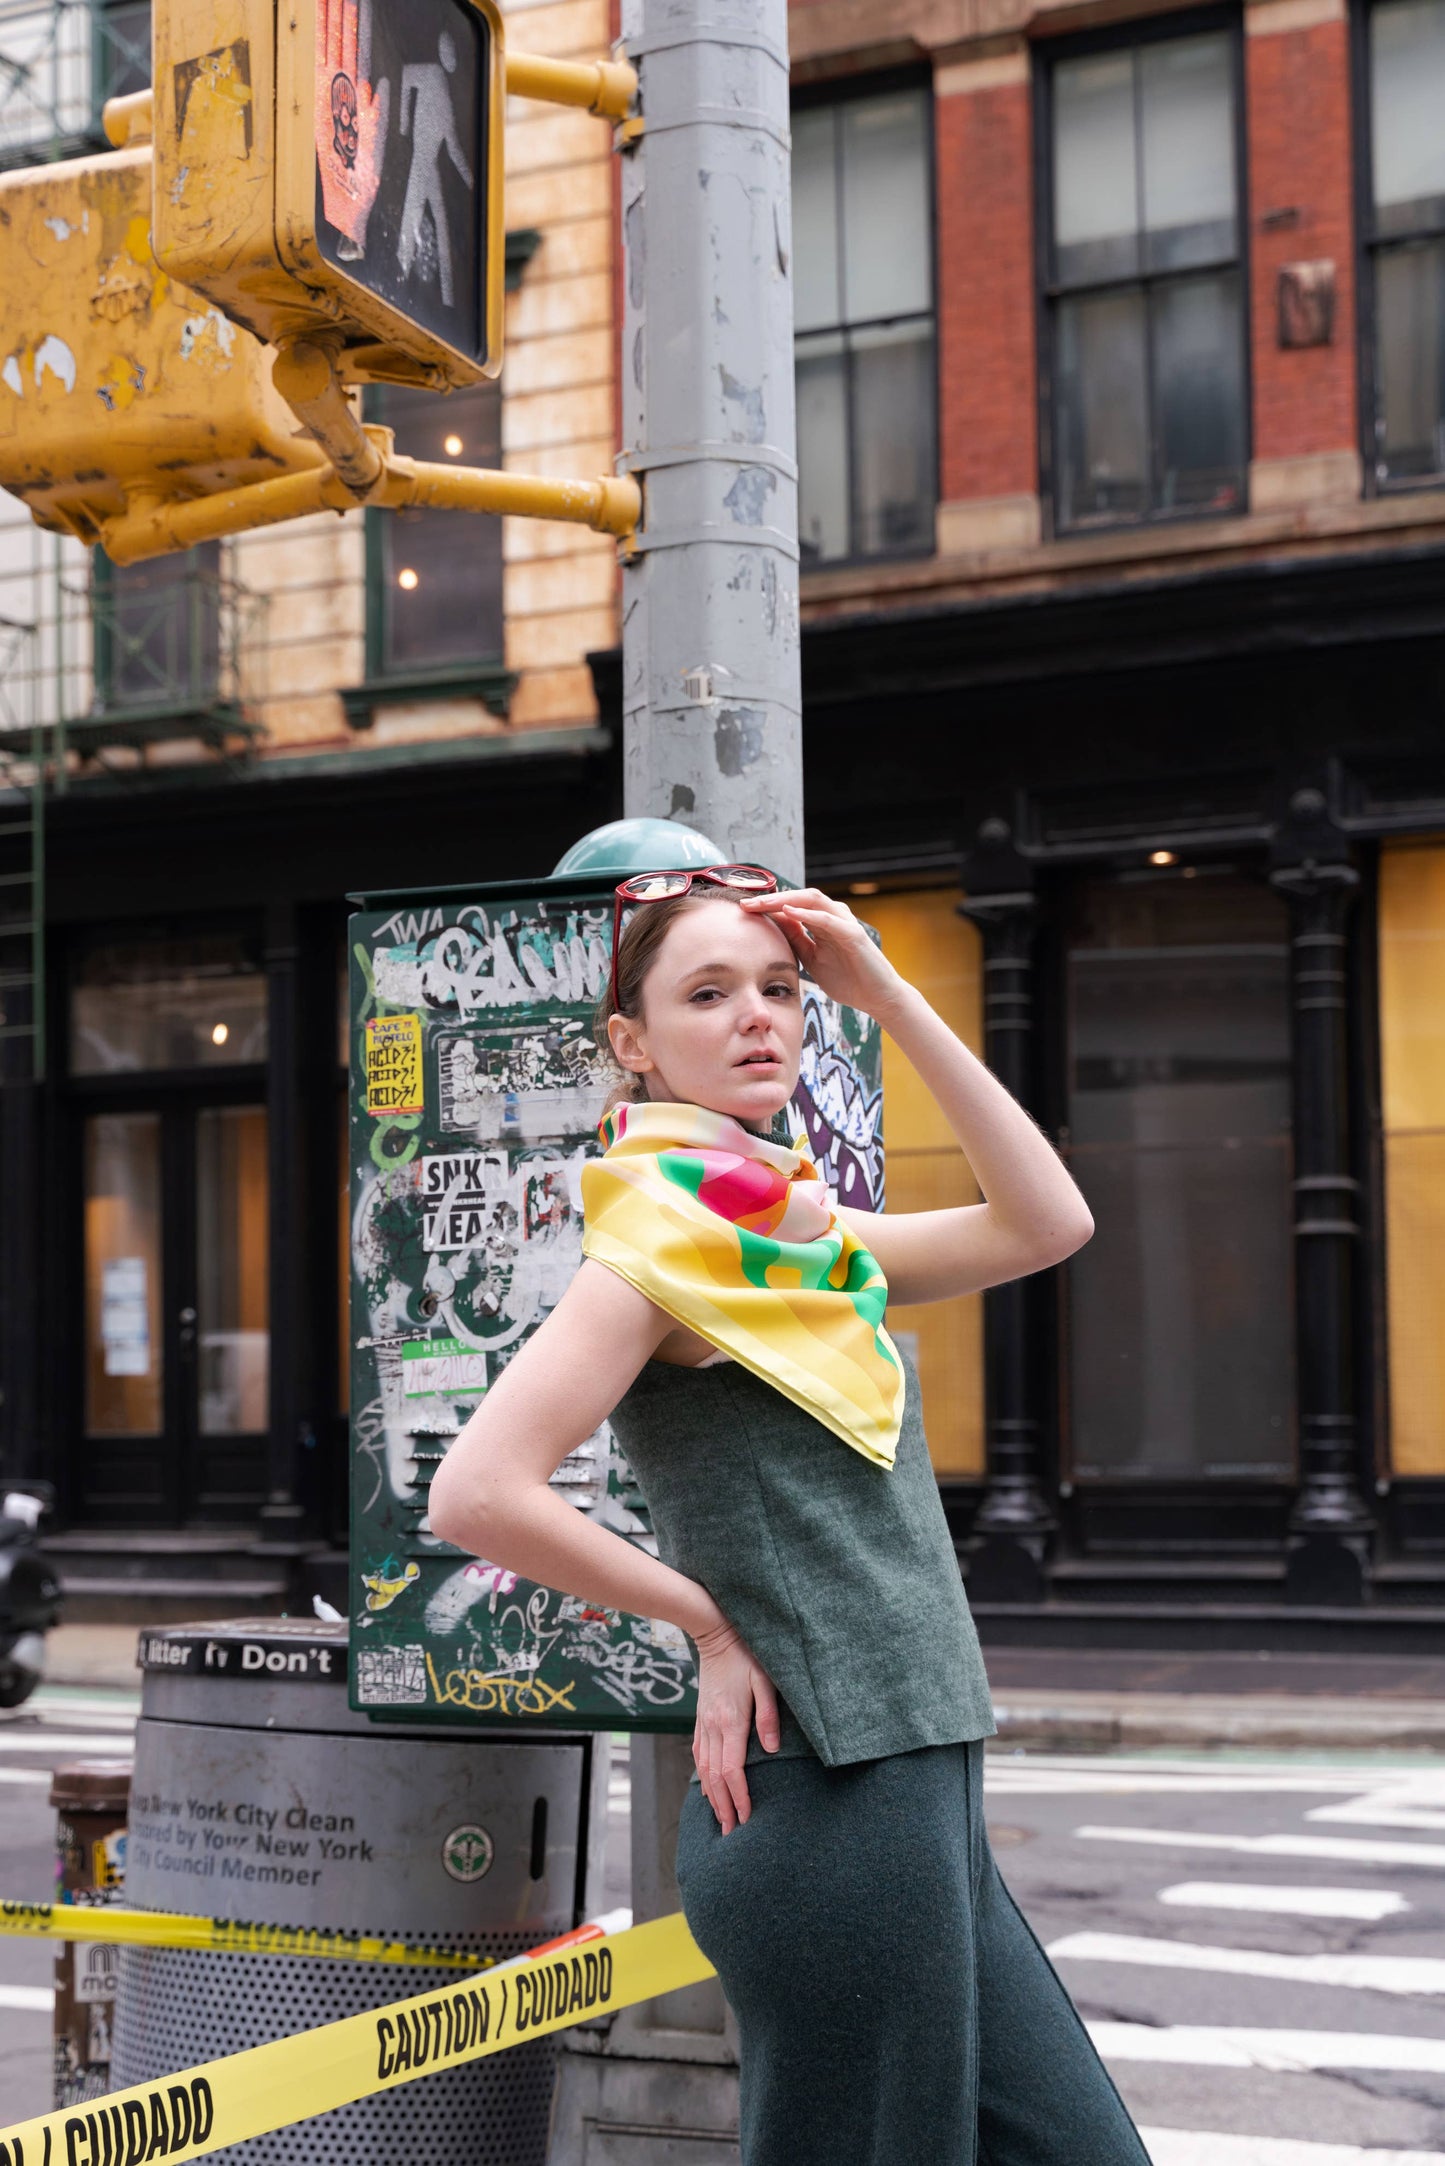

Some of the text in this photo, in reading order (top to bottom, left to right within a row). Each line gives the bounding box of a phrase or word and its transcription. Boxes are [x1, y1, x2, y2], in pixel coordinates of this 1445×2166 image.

[423, 1340, 467, 1352] HELLO
[148, 1640, 192, 1665] litter
[241, 1644, 332, 1673] Don't
[186, 1799, 227, 1822] York
[234, 1804, 278, 1832] City
[284, 1808, 355, 1832] Clean
[177, 1825, 197, 1850] by
[255, 1833, 309, 1858] New
[318, 1839, 374, 1862] York
[154, 1850, 215, 1877] Council
[376, 1987, 490, 2080] CAUTION
[515, 1947, 613, 2032] CUIDADO
[65, 2077, 214, 2166] CUIDADO
